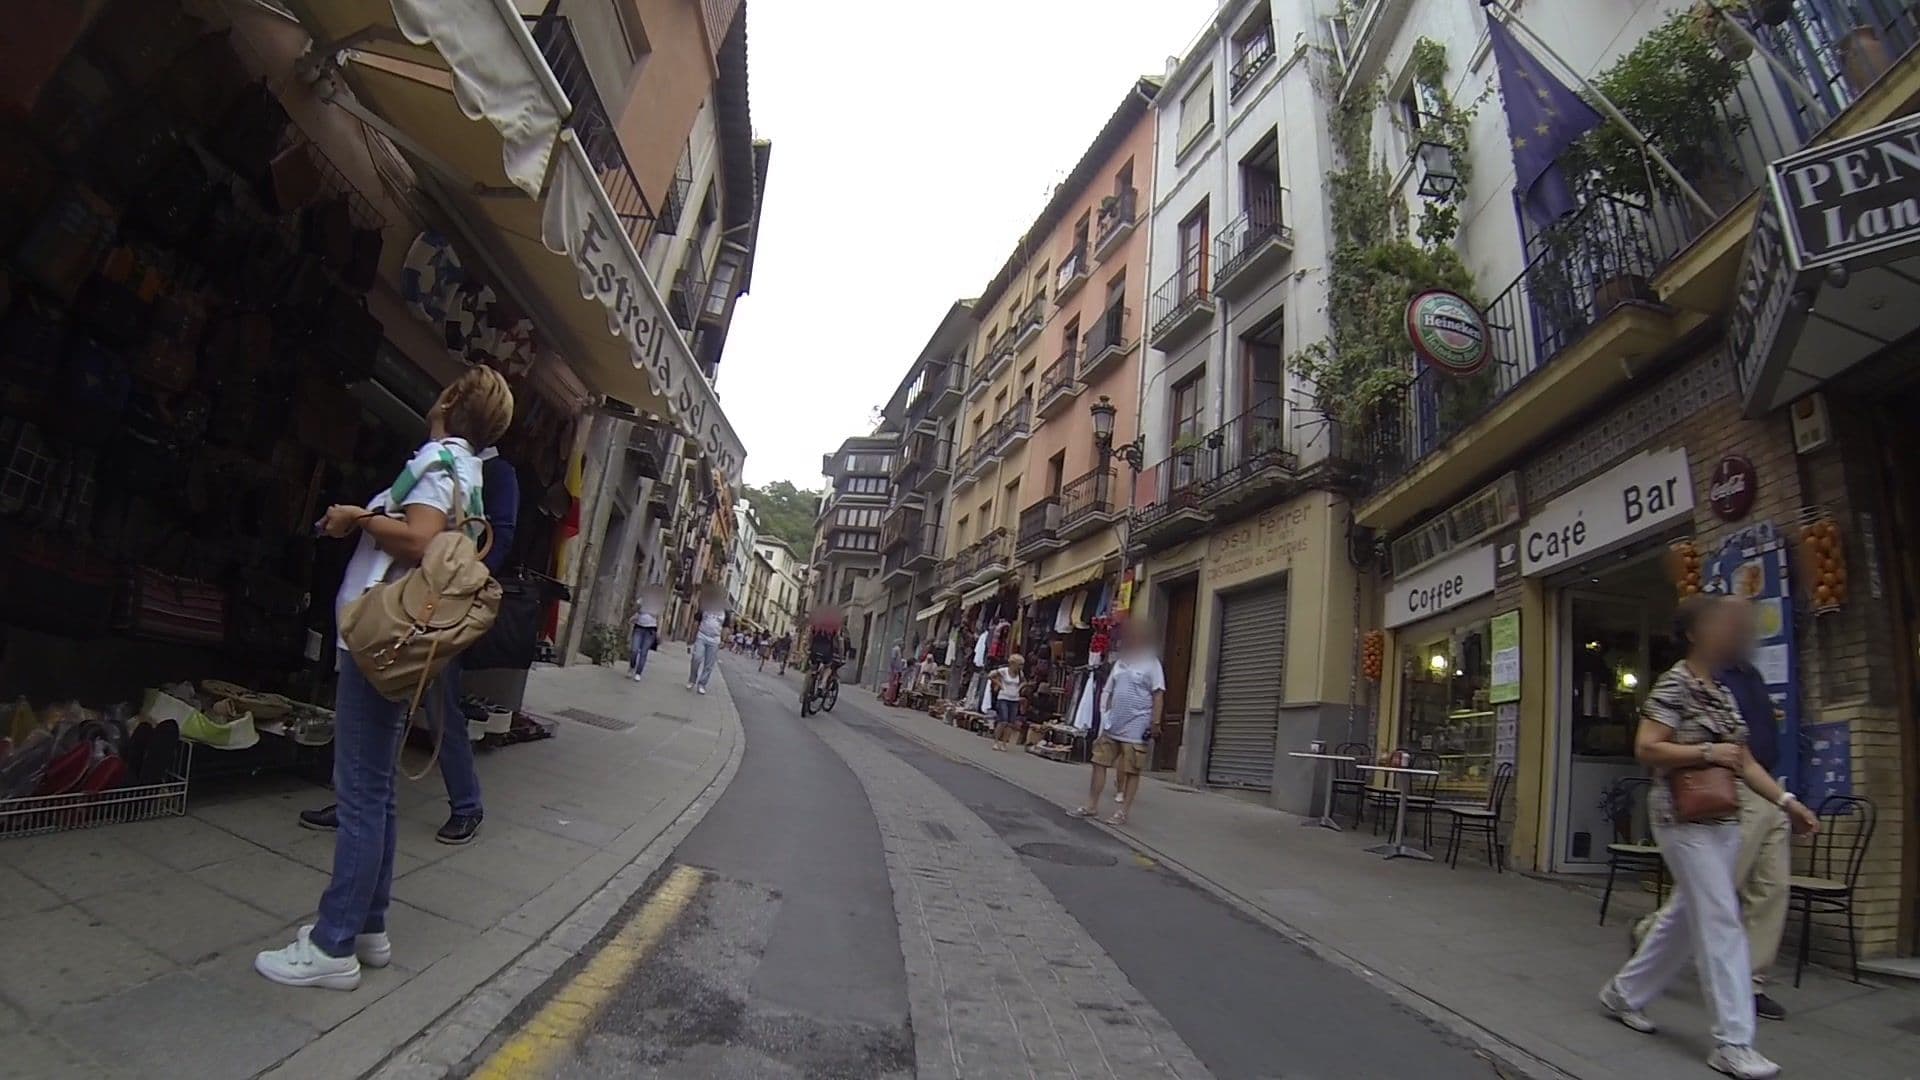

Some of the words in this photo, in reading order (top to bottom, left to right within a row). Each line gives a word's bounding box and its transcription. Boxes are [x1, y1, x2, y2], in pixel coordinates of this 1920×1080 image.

[1789, 132, 1920, 209] PEN
[1822, 197, 1920, 249] Lan
[580, 212, 672, 390] Estrella
[680, 377, 706, 428] del
[707, 423, 735, 472] Sur
[1424, 314, 1482, 339] Heineken
[1259, 503, 1312, 547] Ferrer
[1527, 510, 1587, 563] Café
[1623, 476, 1678, 525] Bar
[1408, 574, 1464, 613] Coffee
